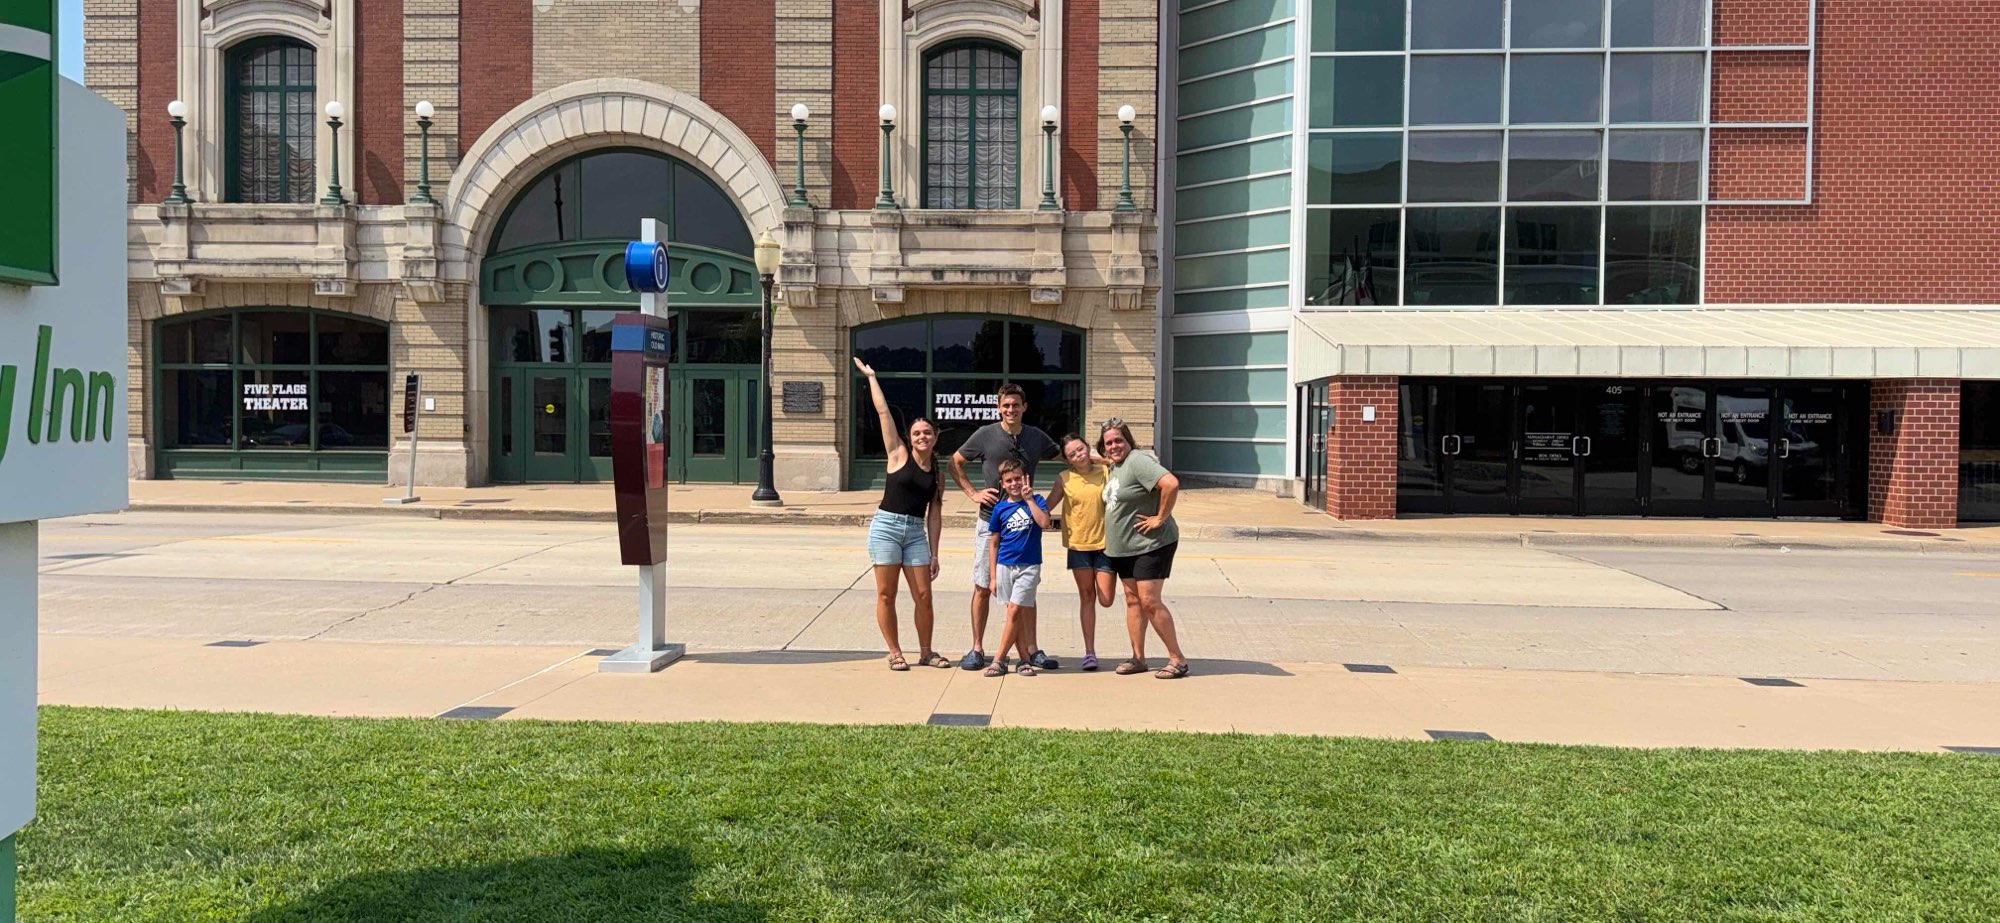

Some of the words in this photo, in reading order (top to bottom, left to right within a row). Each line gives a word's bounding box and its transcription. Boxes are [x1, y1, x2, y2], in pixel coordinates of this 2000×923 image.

[28, 324, 115, 444] Inn
[244, 384, 270, 395] FIVE
[272, 384, 307, 395] FLAGS
[1606, 385, 1622, 395] 405
[243, 397, 308, 411] THEATER
[935, 393, 962, 404] FIVE
[964, 394, 999, 405] FLAGS
[935, 407, 1001, 420] THEATER
